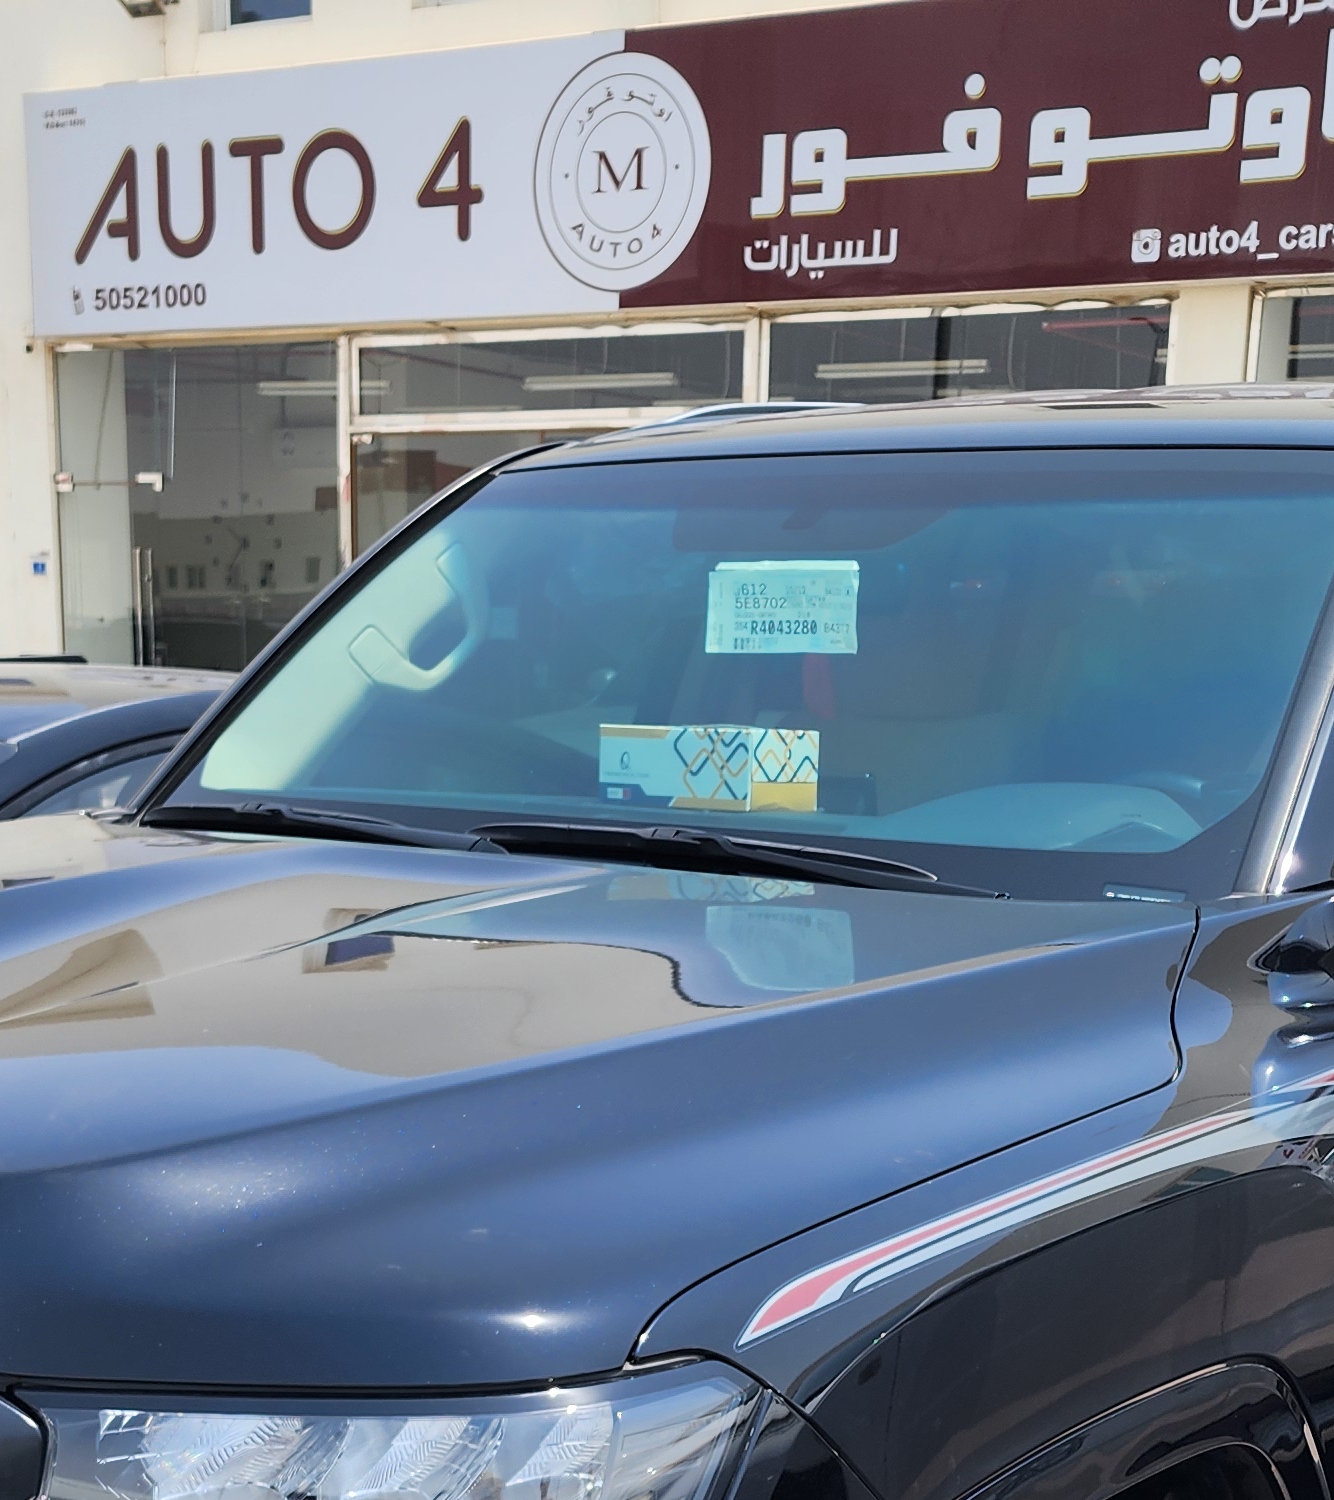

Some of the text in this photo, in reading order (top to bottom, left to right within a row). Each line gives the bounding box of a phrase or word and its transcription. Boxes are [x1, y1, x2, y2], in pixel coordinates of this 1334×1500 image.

[591, 145, 651, 194] M
[750, 72, 1002, 219] فور
[74, 115, 484, 265] AUTO 4
[571, 222, 663, 258] AUTO 4
[743, 229, 898, 280] للسيارات
[92, 282, 208, 312] 50521000
